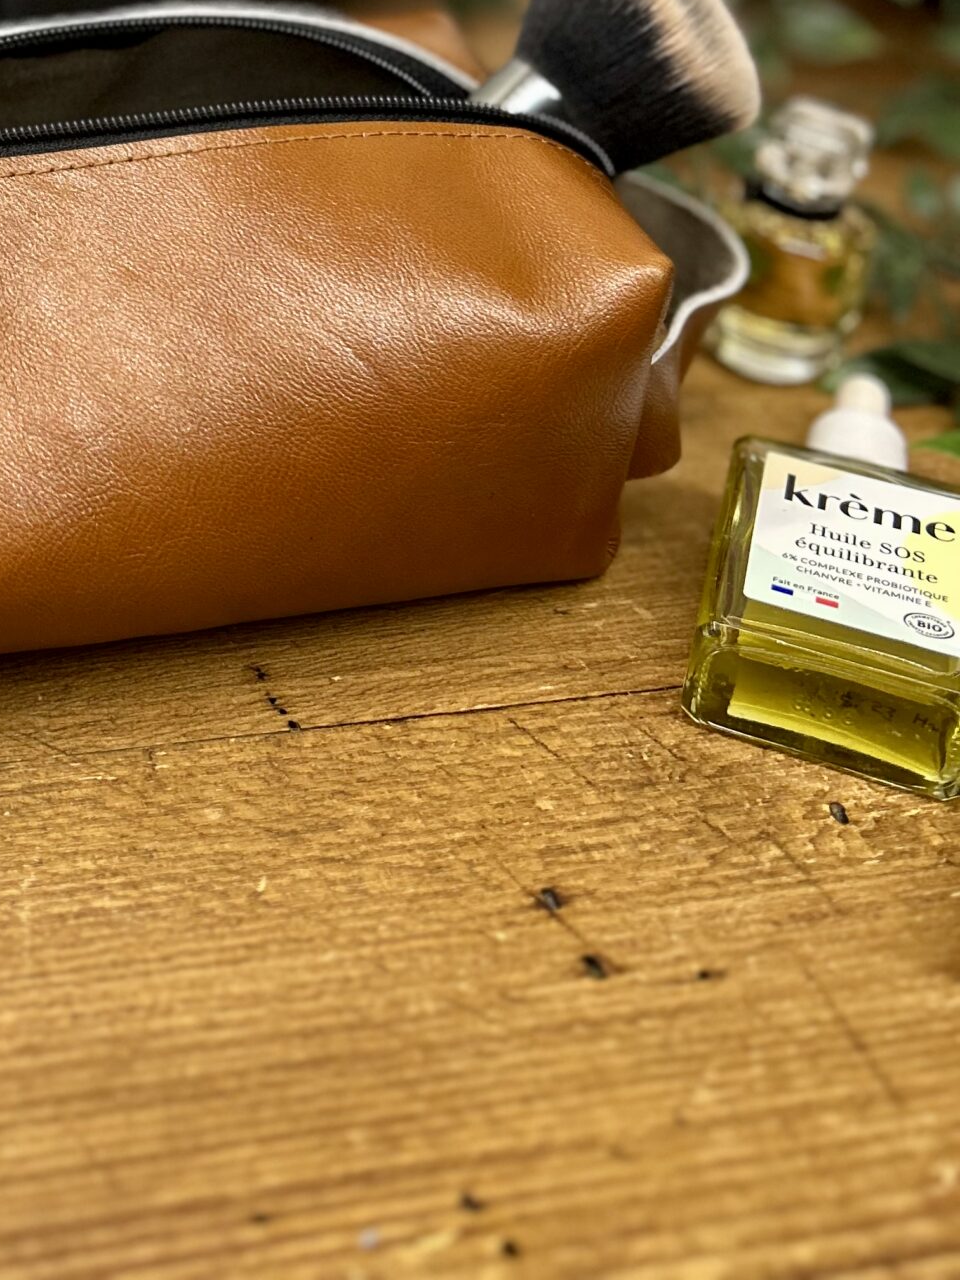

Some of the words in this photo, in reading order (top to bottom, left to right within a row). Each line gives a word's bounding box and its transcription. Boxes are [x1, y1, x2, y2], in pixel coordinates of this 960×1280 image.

[784, 473, 956, 543] krème
[795, 537, 939, 584] équilibrante
[809, 522, 872, 550] Huile
[879, 542, 926, 564] SOS
[772, 576, 791, 587] Fait
[793, 582, 805, 591] en
[807, 585, 840, 600] France
[782, 552, 798, 562] 6%
[800, 557, 864, 580] COMPLEXE
[866, 575, 949, 603] PROBIOTIQUE
[796, 565, 853, 586] CHANVRE
[864, 584, 922, 605] VITAMINE
[925, 600, 933, 608] E
[917, 620, 942, 632] BIO
